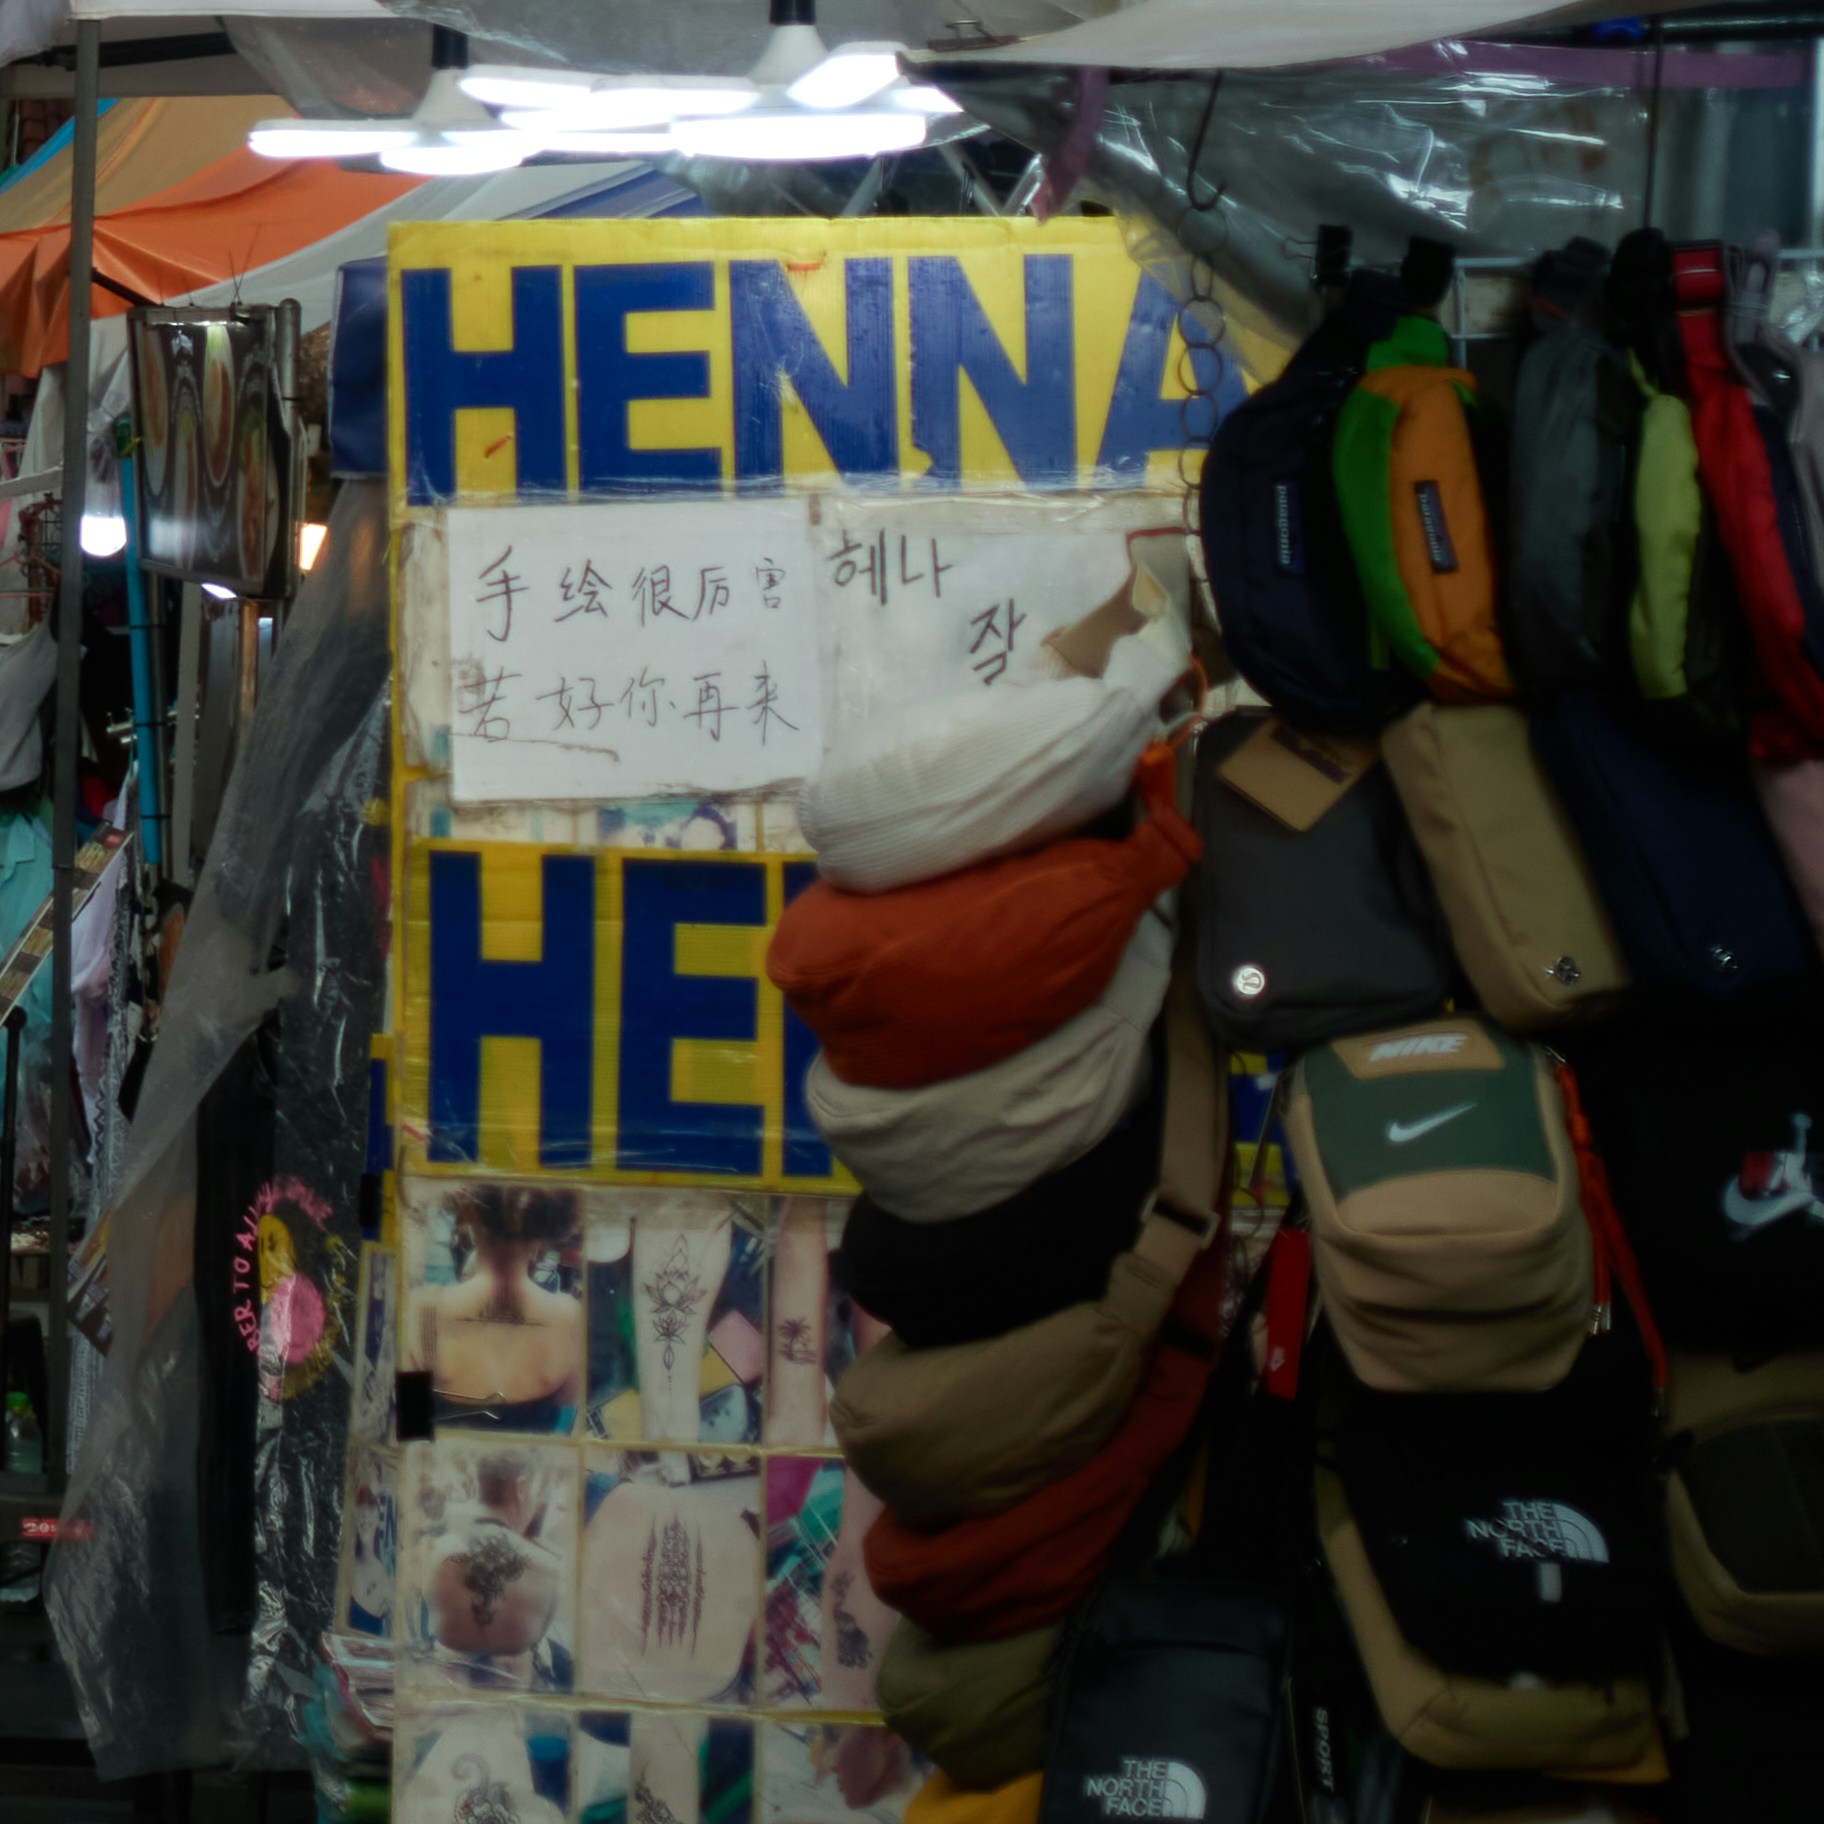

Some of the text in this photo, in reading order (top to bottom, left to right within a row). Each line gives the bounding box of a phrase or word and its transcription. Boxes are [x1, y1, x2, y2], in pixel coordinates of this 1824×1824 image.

[401, 253, 1249, 507] HENNA
[828, 529, 952, 606] 헤나
[1369, 1032, 1468, 1063] NIKE
[1500, 1498, 1555, 1520] THE
[1463, 1518, 1561, 1539] NORTH
[1312, 1705, 1336, 1793] SPORT
[1122, 1759, 1168, 1778] THE
[1085, 1778, 1166, 1798] NORTH
[1105, 1798, 1165, 1818] FACE
